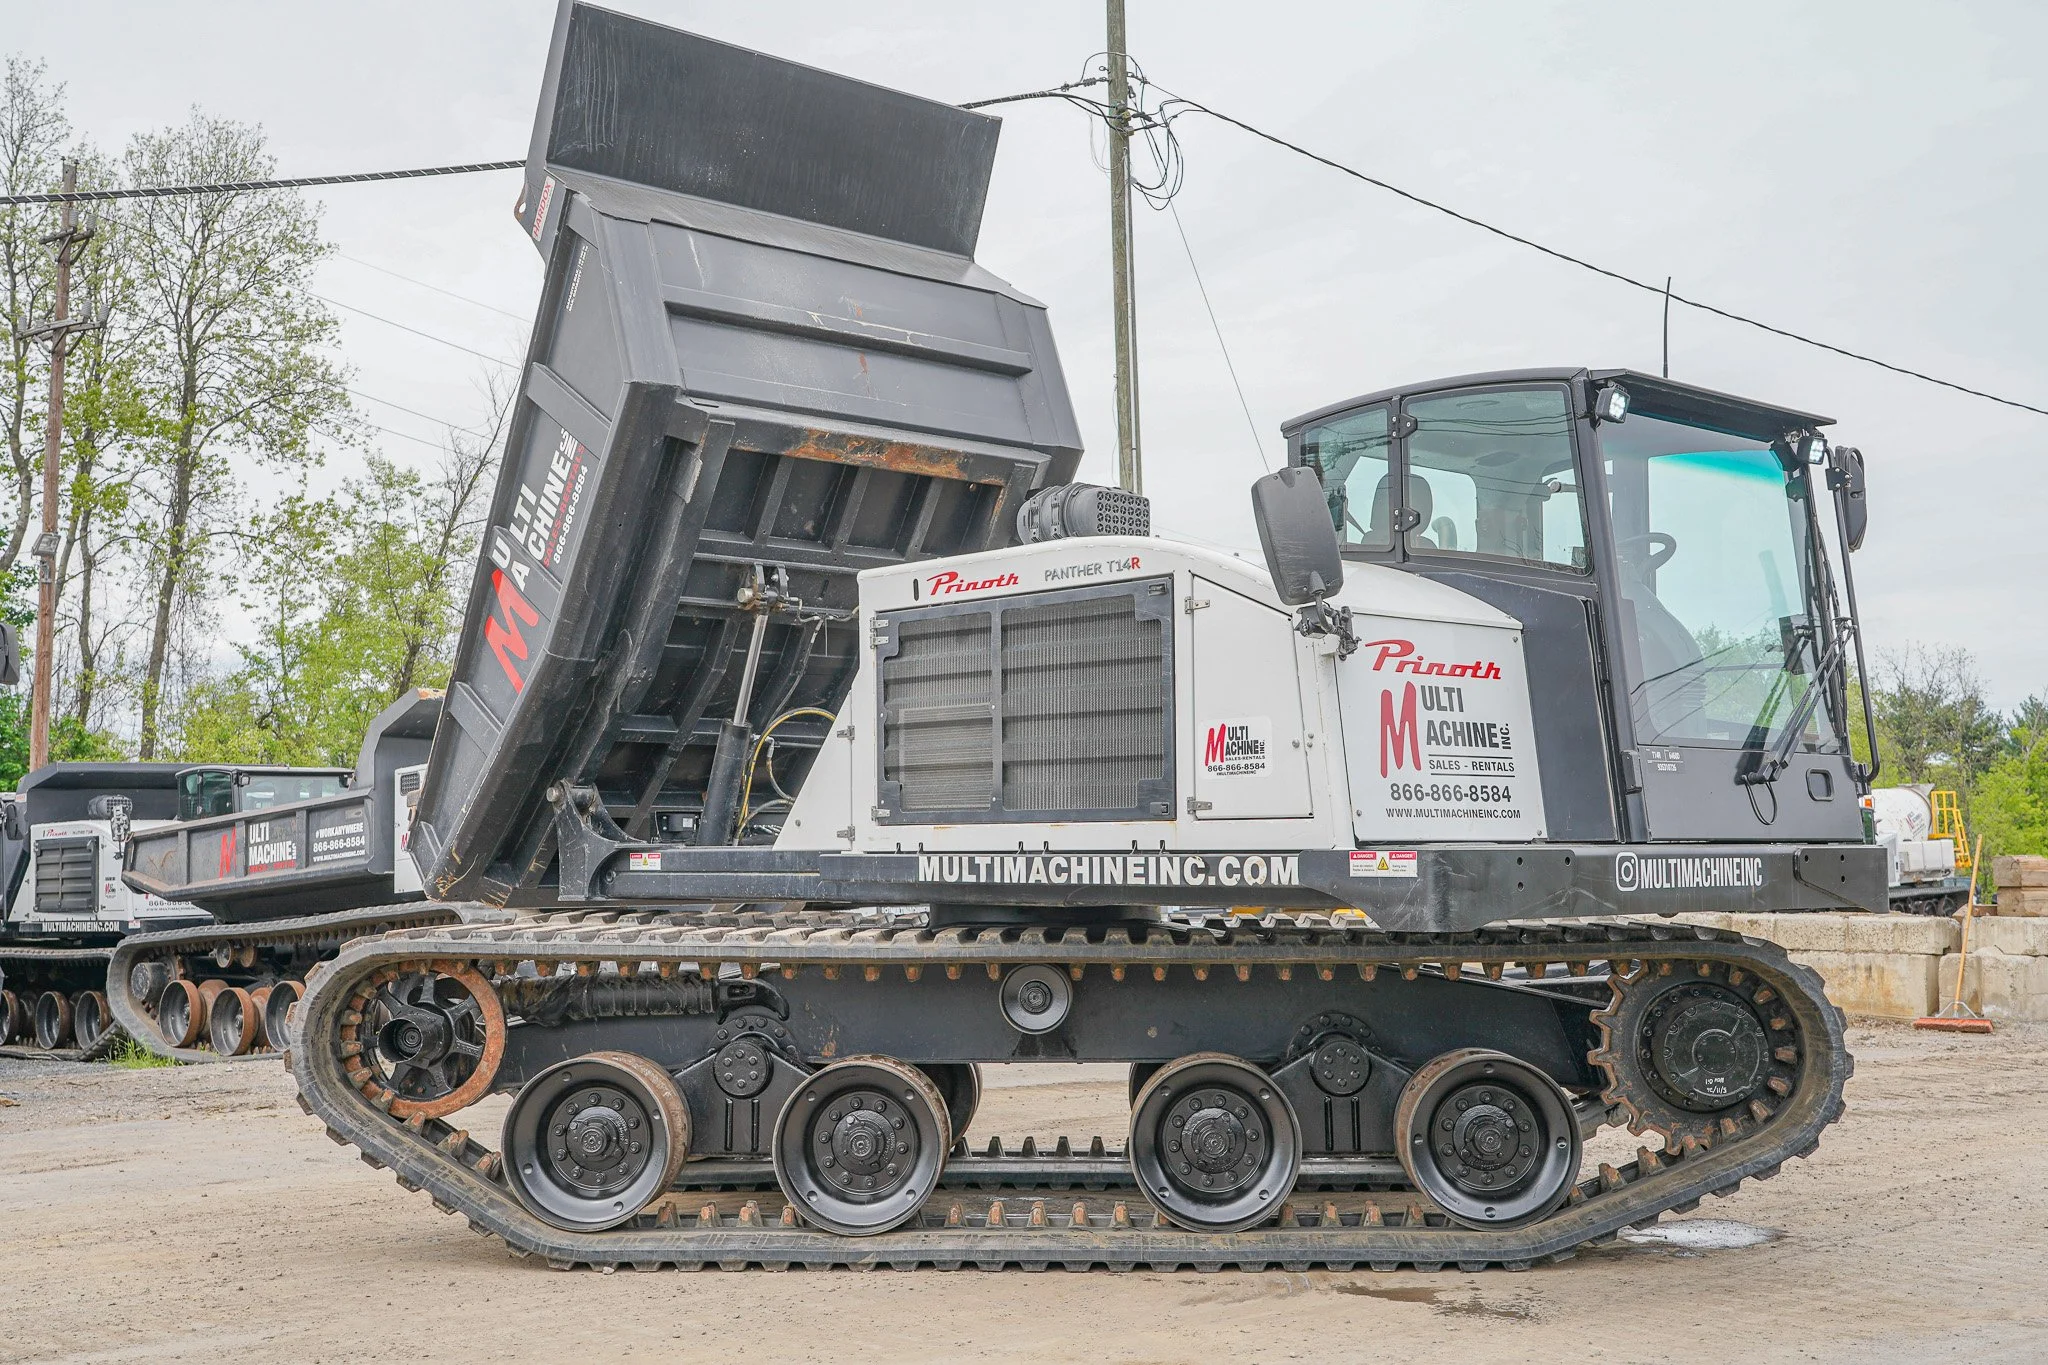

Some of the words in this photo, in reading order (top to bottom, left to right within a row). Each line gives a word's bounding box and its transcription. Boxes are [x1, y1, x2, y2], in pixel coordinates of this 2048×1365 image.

[532, 182, 552, 237] HARDOX
[553, 464, 588, 564] 866-866-8584
[926, 571, 1019, 596] Prinoth
[1044, 561, 1103, 582] PANTHER
[1106, 557, 1141, 573] T14R
[1365, 639, 1501, 680] Prinoth
[1499, 723, 1512, 750] INC.
[1207, 763, 1265, 772] 866-866-8584
[1429, 759, 1461, 771] SALES
[1471, 761, 1515, 772] RENTALS
[1390, 783, 1511, 803] 866-866-8584
[1386, 808, 1521, 819] WWW.MULTIMACHINEINC.COM
[316, 822, 364, 839] #WORKANYWHERE
[248, 840, 292, 866] MACHINE
[313, 836, 365, 852] 866-866-8584
[917, 855, 1300, 887] MULTIMACHINEINC.COM
[1641, 857, 1762, 888] MULTIMACHINEINC
[42, 921, 120, 932] MULTIMACHINEINC.COM
